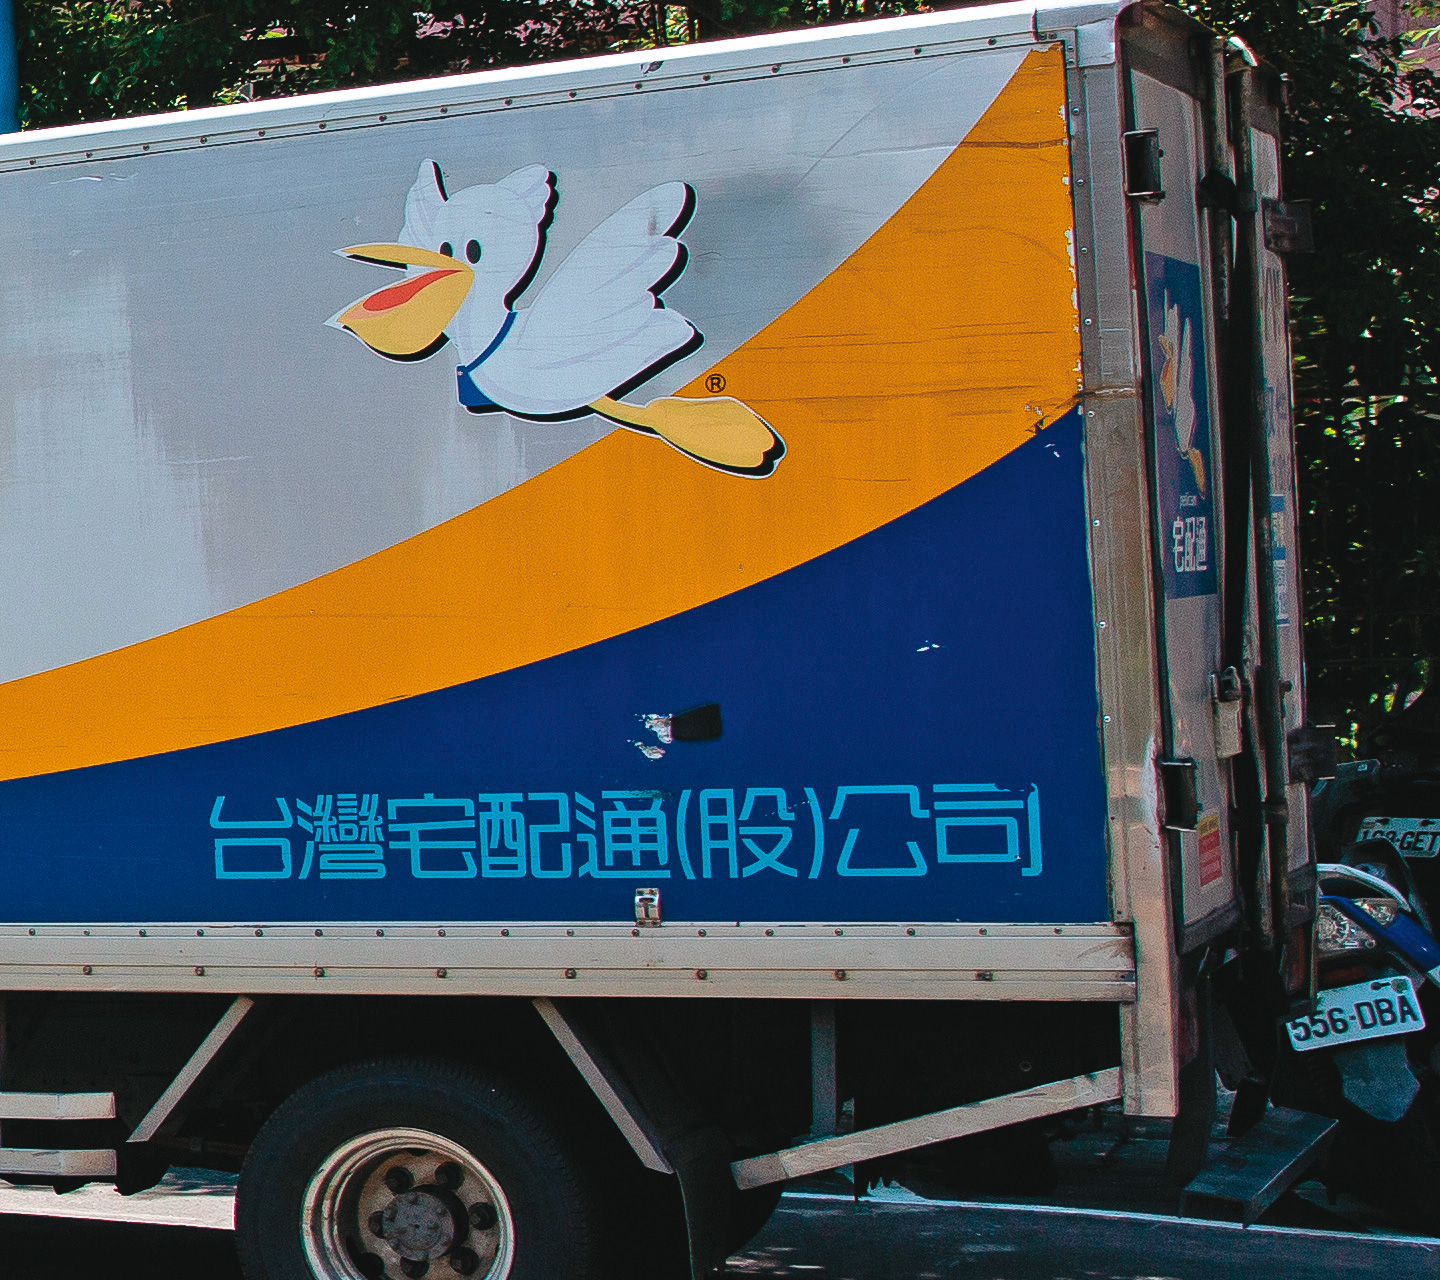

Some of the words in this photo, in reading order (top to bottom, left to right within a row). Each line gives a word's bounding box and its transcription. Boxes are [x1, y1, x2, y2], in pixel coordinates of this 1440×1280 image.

[208, 782, 1044, 880] 台灣宅配通(股)公司
[1290, 995, 1418, 1042] 556-DBA
